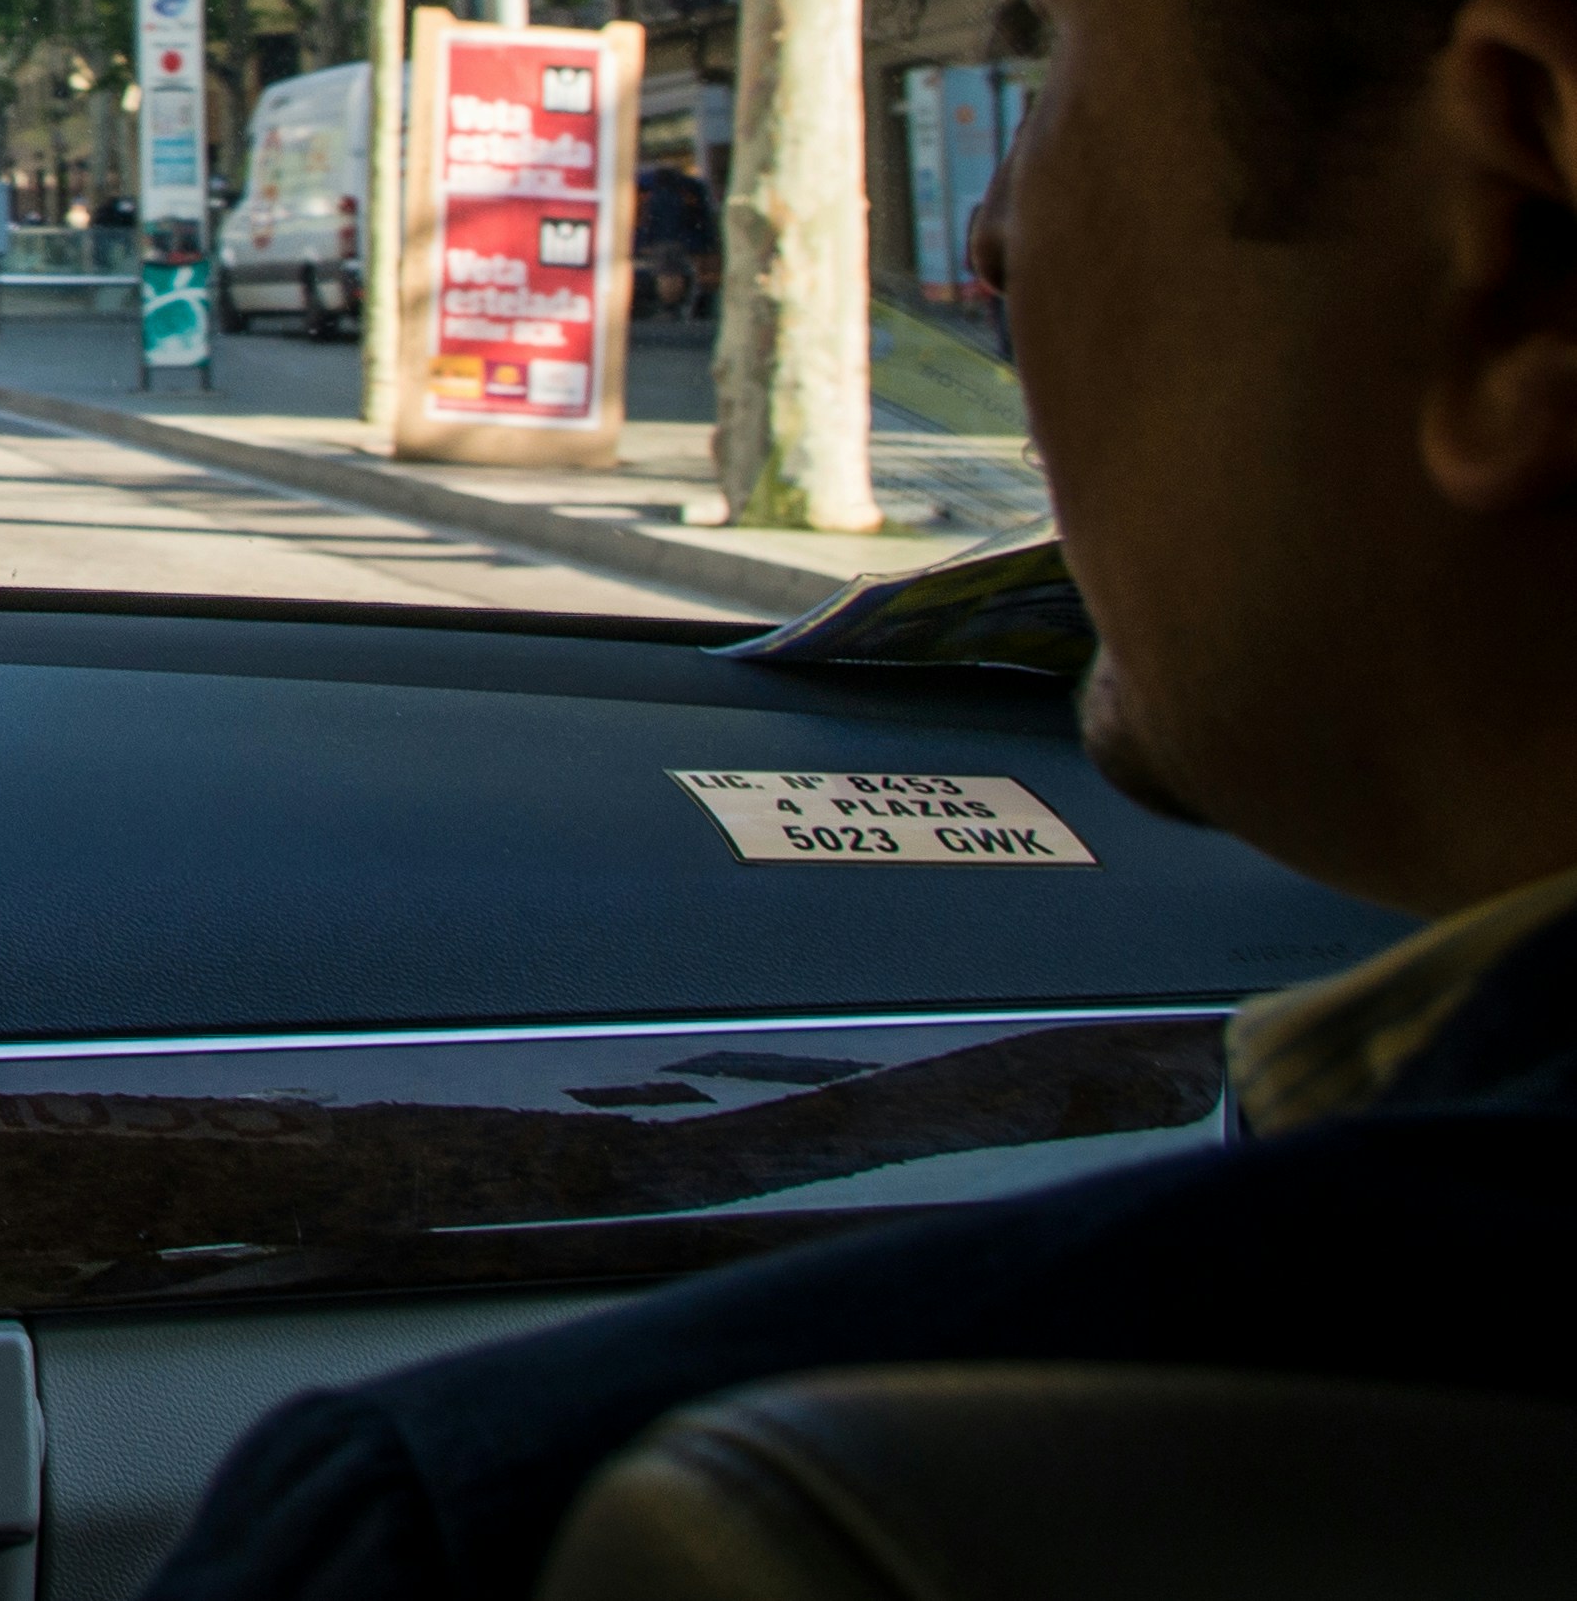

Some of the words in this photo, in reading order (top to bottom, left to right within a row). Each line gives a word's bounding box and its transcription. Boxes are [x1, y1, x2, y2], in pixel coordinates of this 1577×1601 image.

[688, 774, 763, 790] LIC.
[847, 776, 963, 795] 8453
[776, 799, 803, 816] 4
[831, 799, 997, 819] PLAZAS
[782, 825, 900, 853] 5023
[934, 827, 1055, 856] GWK
